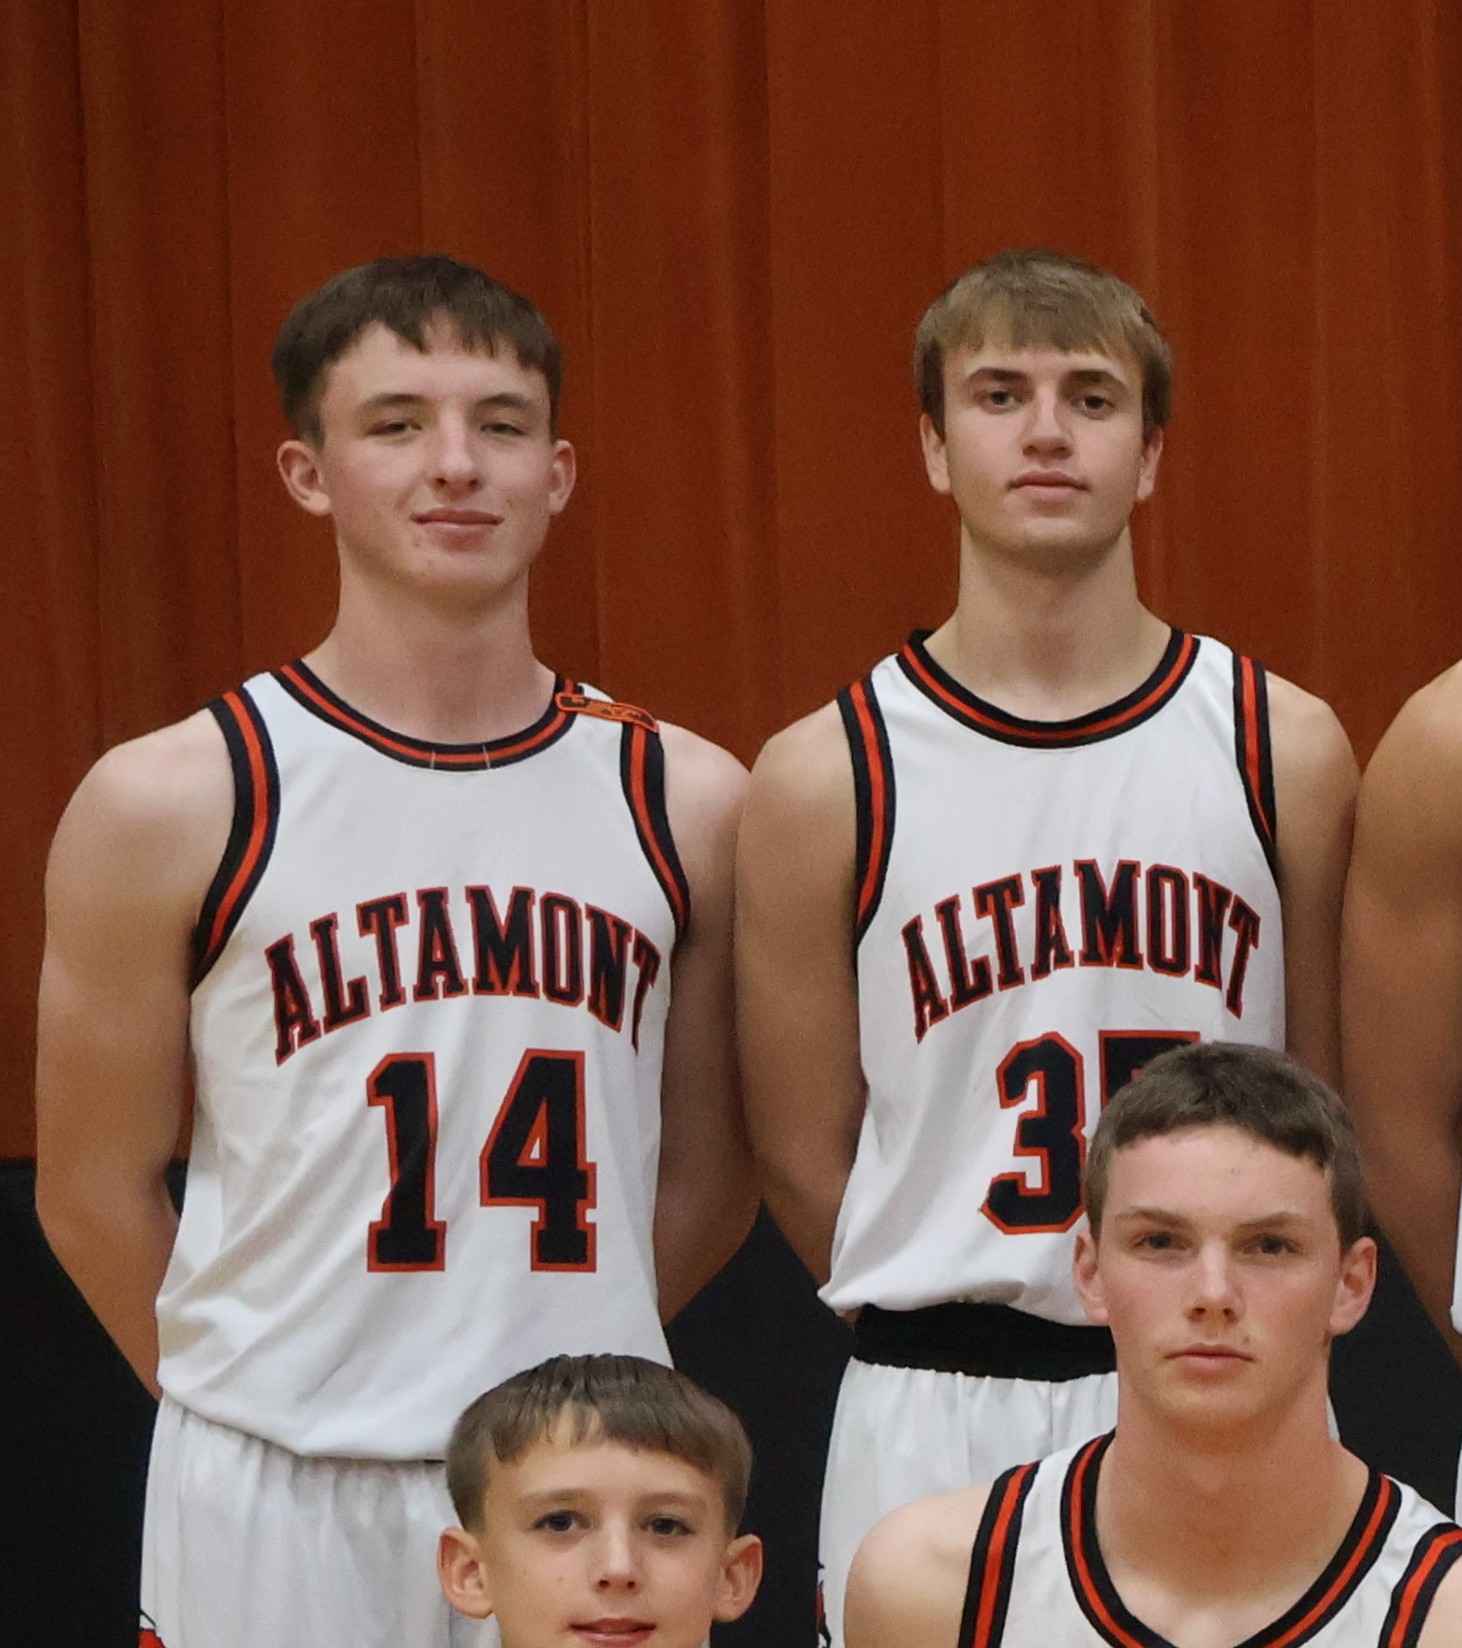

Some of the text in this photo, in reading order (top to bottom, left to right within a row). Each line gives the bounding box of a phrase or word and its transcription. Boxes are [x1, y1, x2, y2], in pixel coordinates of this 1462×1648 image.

[264, 886, 661, 1066] ALTAMONT
[901, 859, 1261, 1043] ALTAMONT
[366, 1048, 597, 1273] 14
